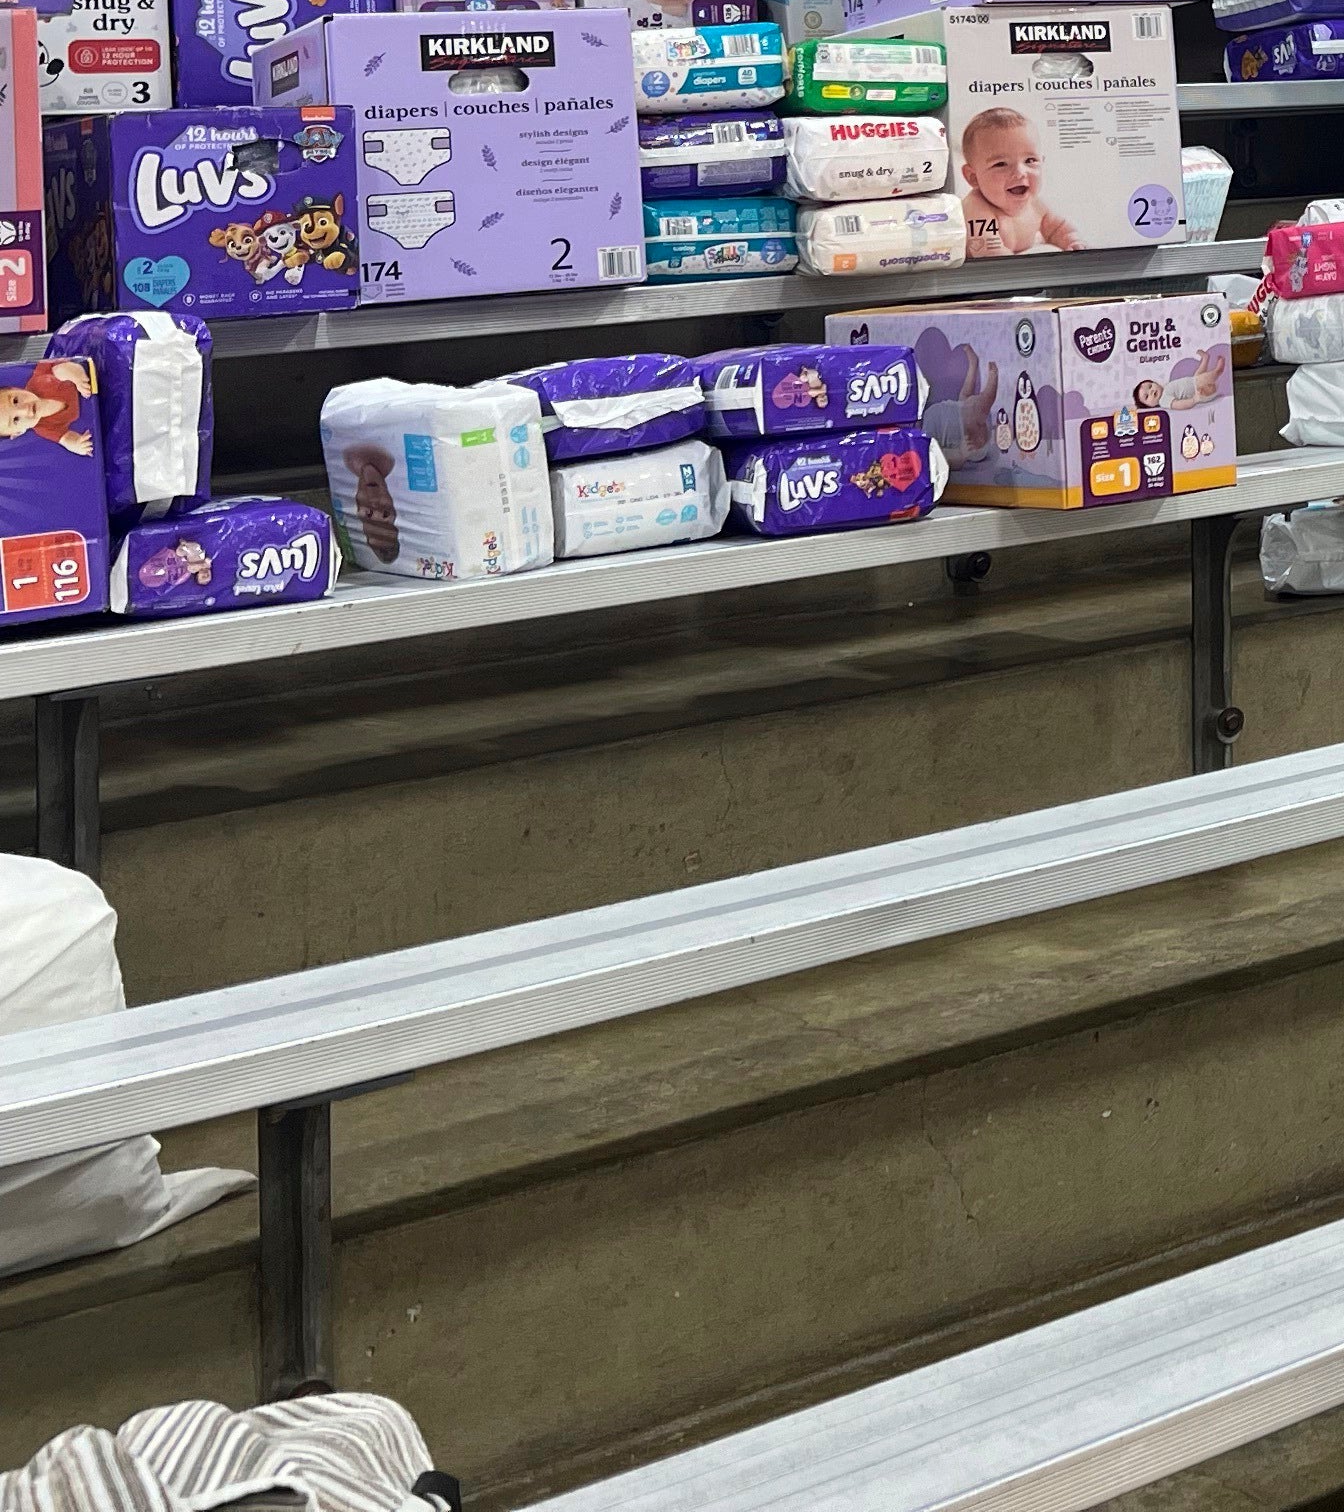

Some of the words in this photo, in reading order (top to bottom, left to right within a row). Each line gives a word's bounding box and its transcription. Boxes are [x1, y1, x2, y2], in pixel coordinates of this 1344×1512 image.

[93, 14, 135, 35] dry
[1014, 25, 1107, 41] KIRKLAND
[428, 36, 550, 56] KIRKLAND
[132, 82, 151, 103] 3
[969, 79, 1024, 95] diapers
[1035, 76, 1093, 90] couches
[1103, 74, 1156, 90] pañales
[364, 102, 439, 121] diapers
[453, 100, 530, 117] couches
[544, 96, 614, 113] pañales
[186, 127, 204, 141] 12
[208, 127, 257, 141] hours
[519, 128, 550, 140] stylish
[553, 127, 589, 138] designs
[830, 121, 919, 142] HUGGIES
[1133, 198, 1151, 227] 2
[968, 219, 998, 237] 174
[550, 237, 573, 271] 2
[361, 261, 402, 283] 174
[1079, 327, 1116, 348] Parent's
[1129, 320, 1159, 337] Dry
[1164, 318, 1176, 333] &
[1087, 342, 1111, 355] CHOICE
[1126, 333, 1181, 353] Gentle
[1139, 353, 1170, 364] Diapers
[1146, 456, 1161, 465] 162
[1095, 471, 1115, 483] Size
[1119, 463, 1131, 487] 1
[54, 559, 79, 601] 116
